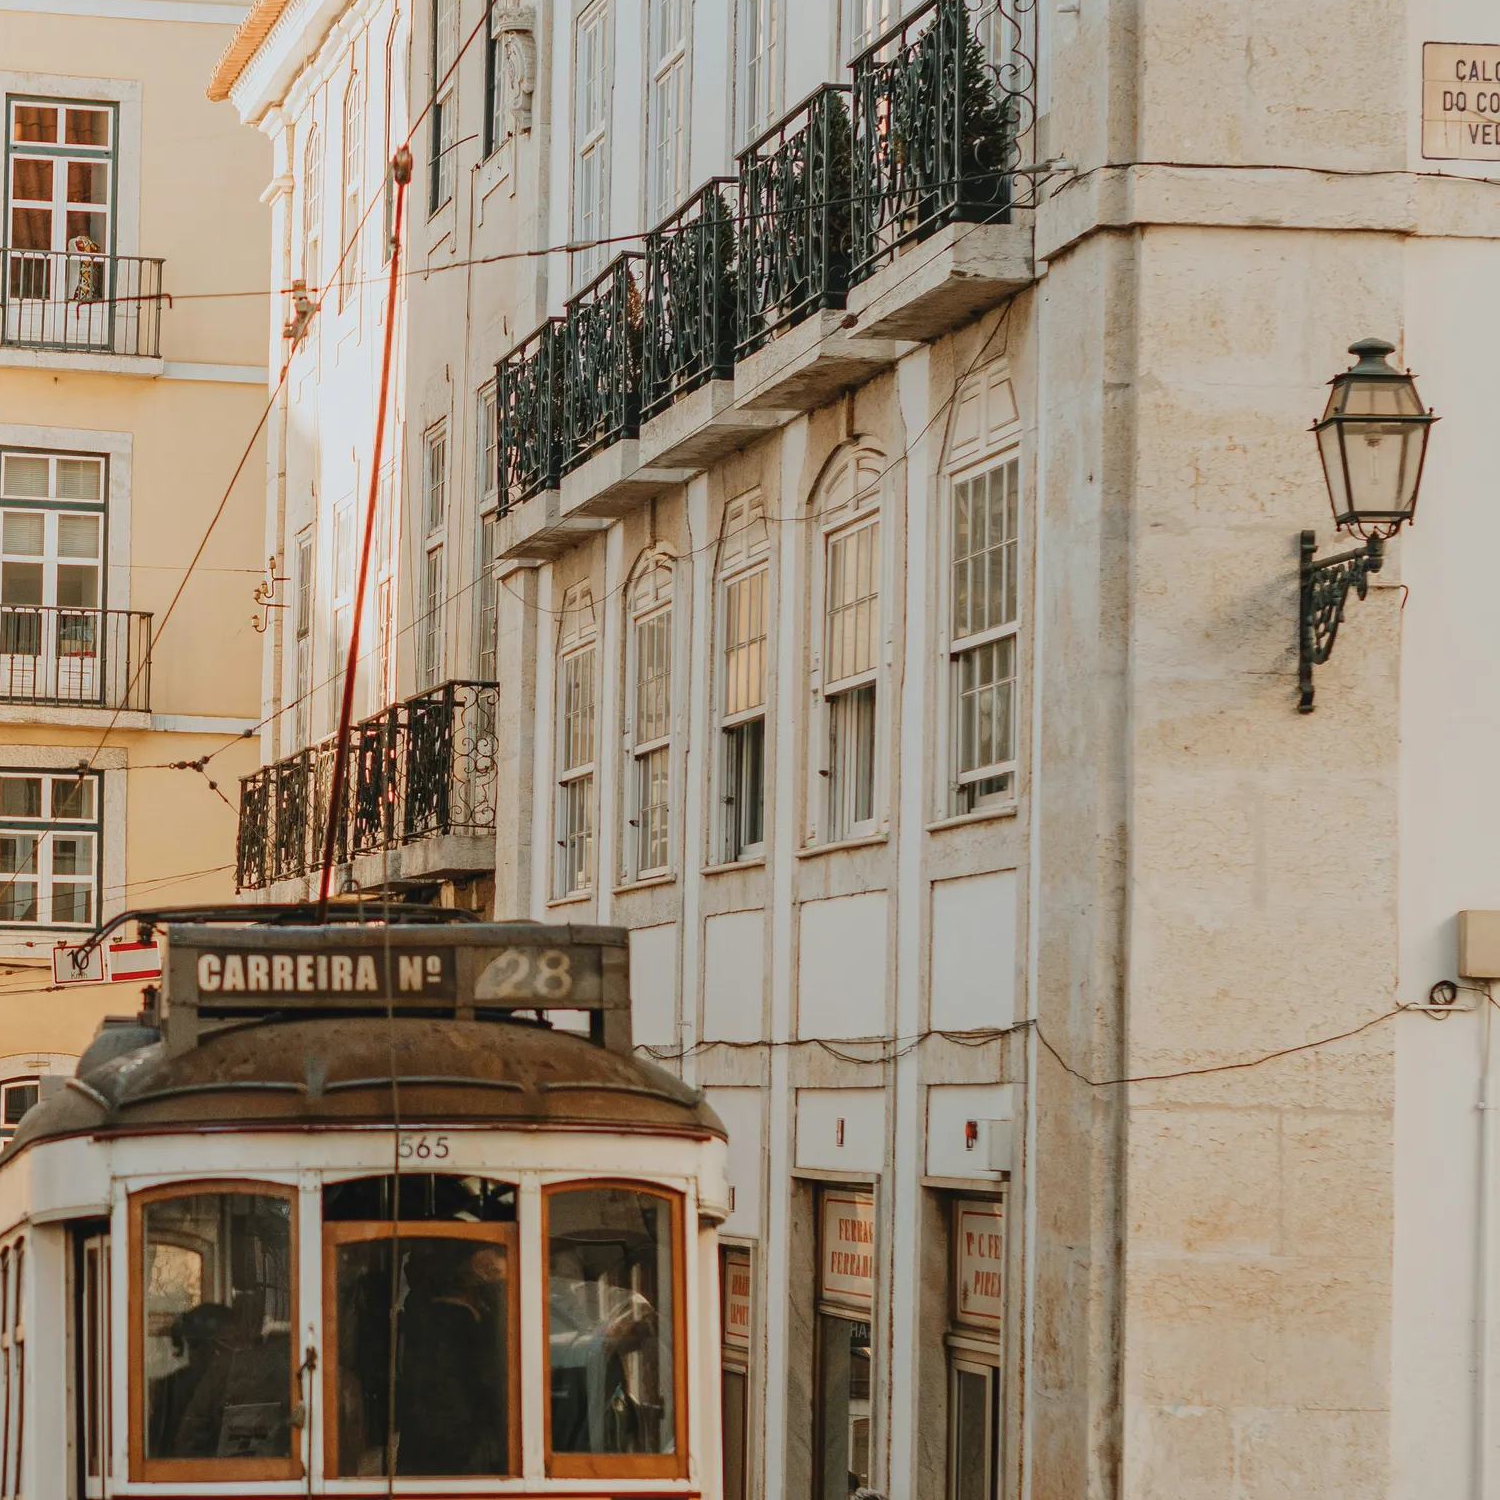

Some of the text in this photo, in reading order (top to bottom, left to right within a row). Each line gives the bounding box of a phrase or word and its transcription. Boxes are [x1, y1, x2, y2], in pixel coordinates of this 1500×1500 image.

[1443, 90, 1467, 112] DO
[198, 953, 379, 992] CARREIRA
[498, 949, 573, 999] 28
[398, 1135, 449, 1159] 565
